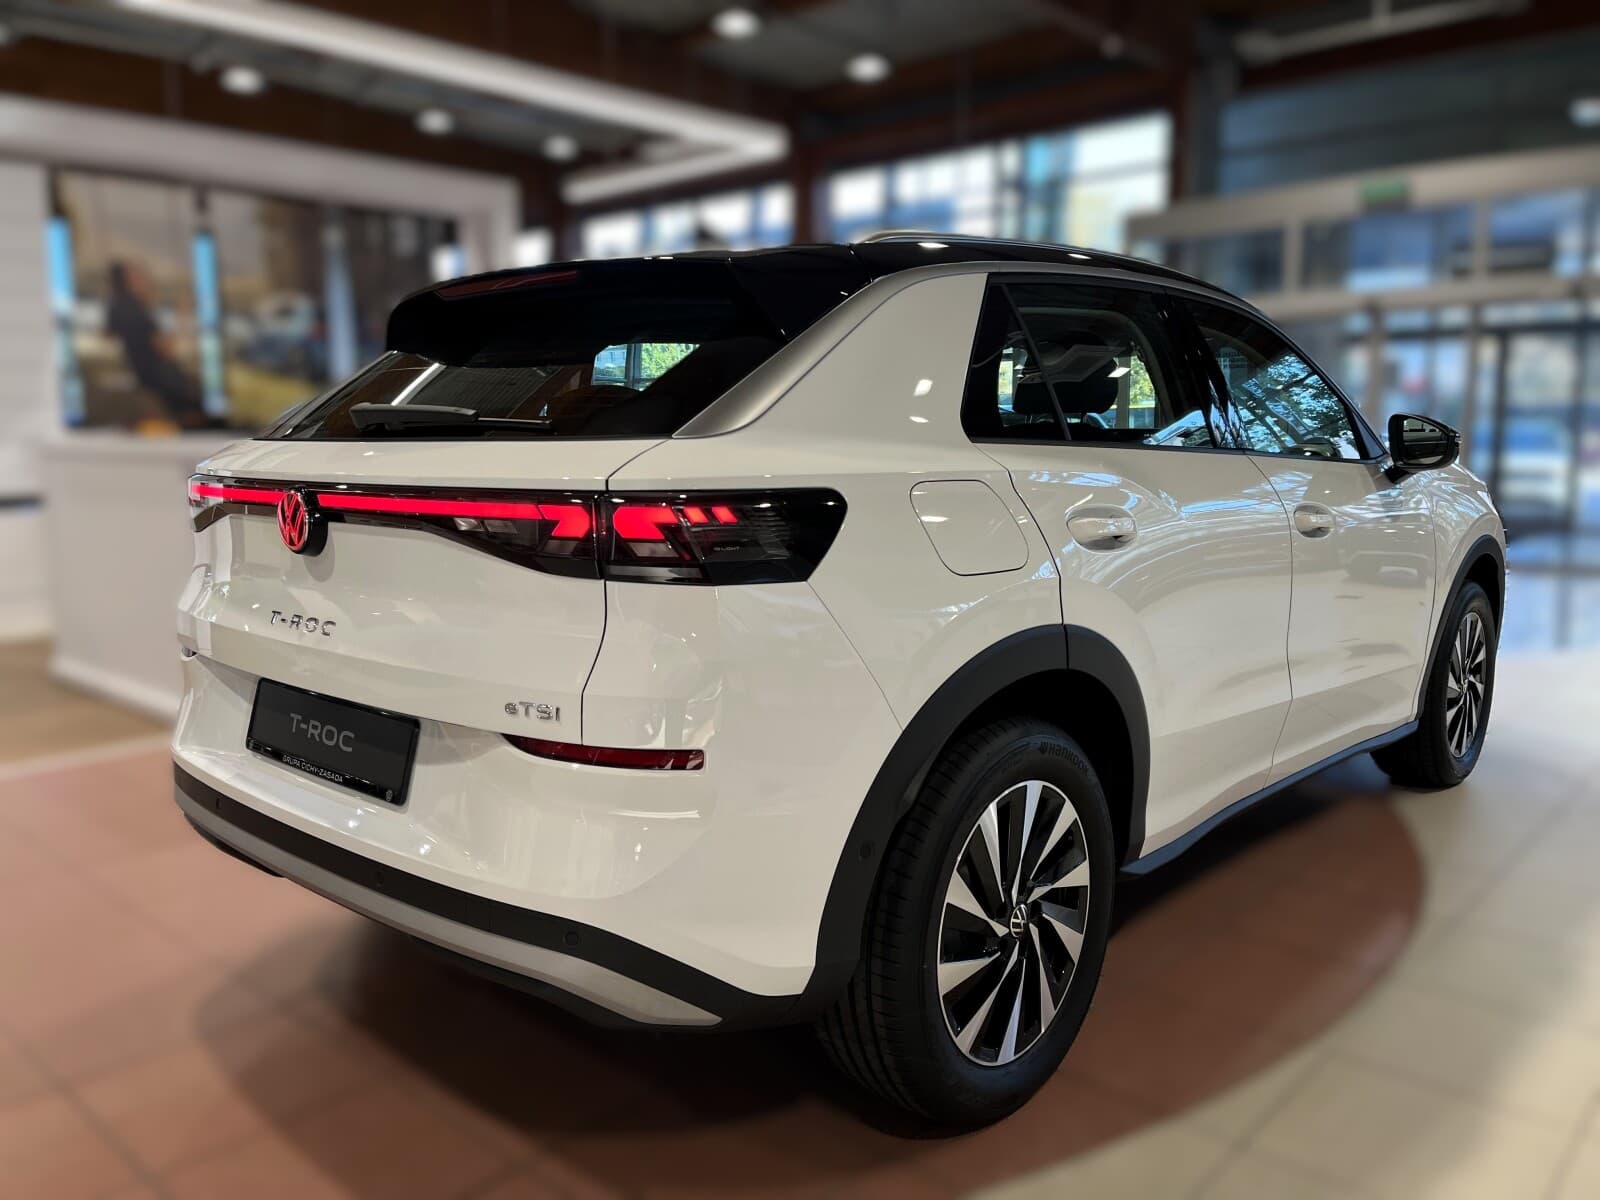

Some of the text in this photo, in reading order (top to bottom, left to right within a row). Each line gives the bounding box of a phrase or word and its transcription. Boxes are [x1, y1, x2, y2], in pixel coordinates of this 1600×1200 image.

[271, 610, 336, 637] T-ROC
[504, 701, 561, 721] eTSI
[289, 713, 356, 753] T-ROC
[282, 754, 301, 768] GRUPA
